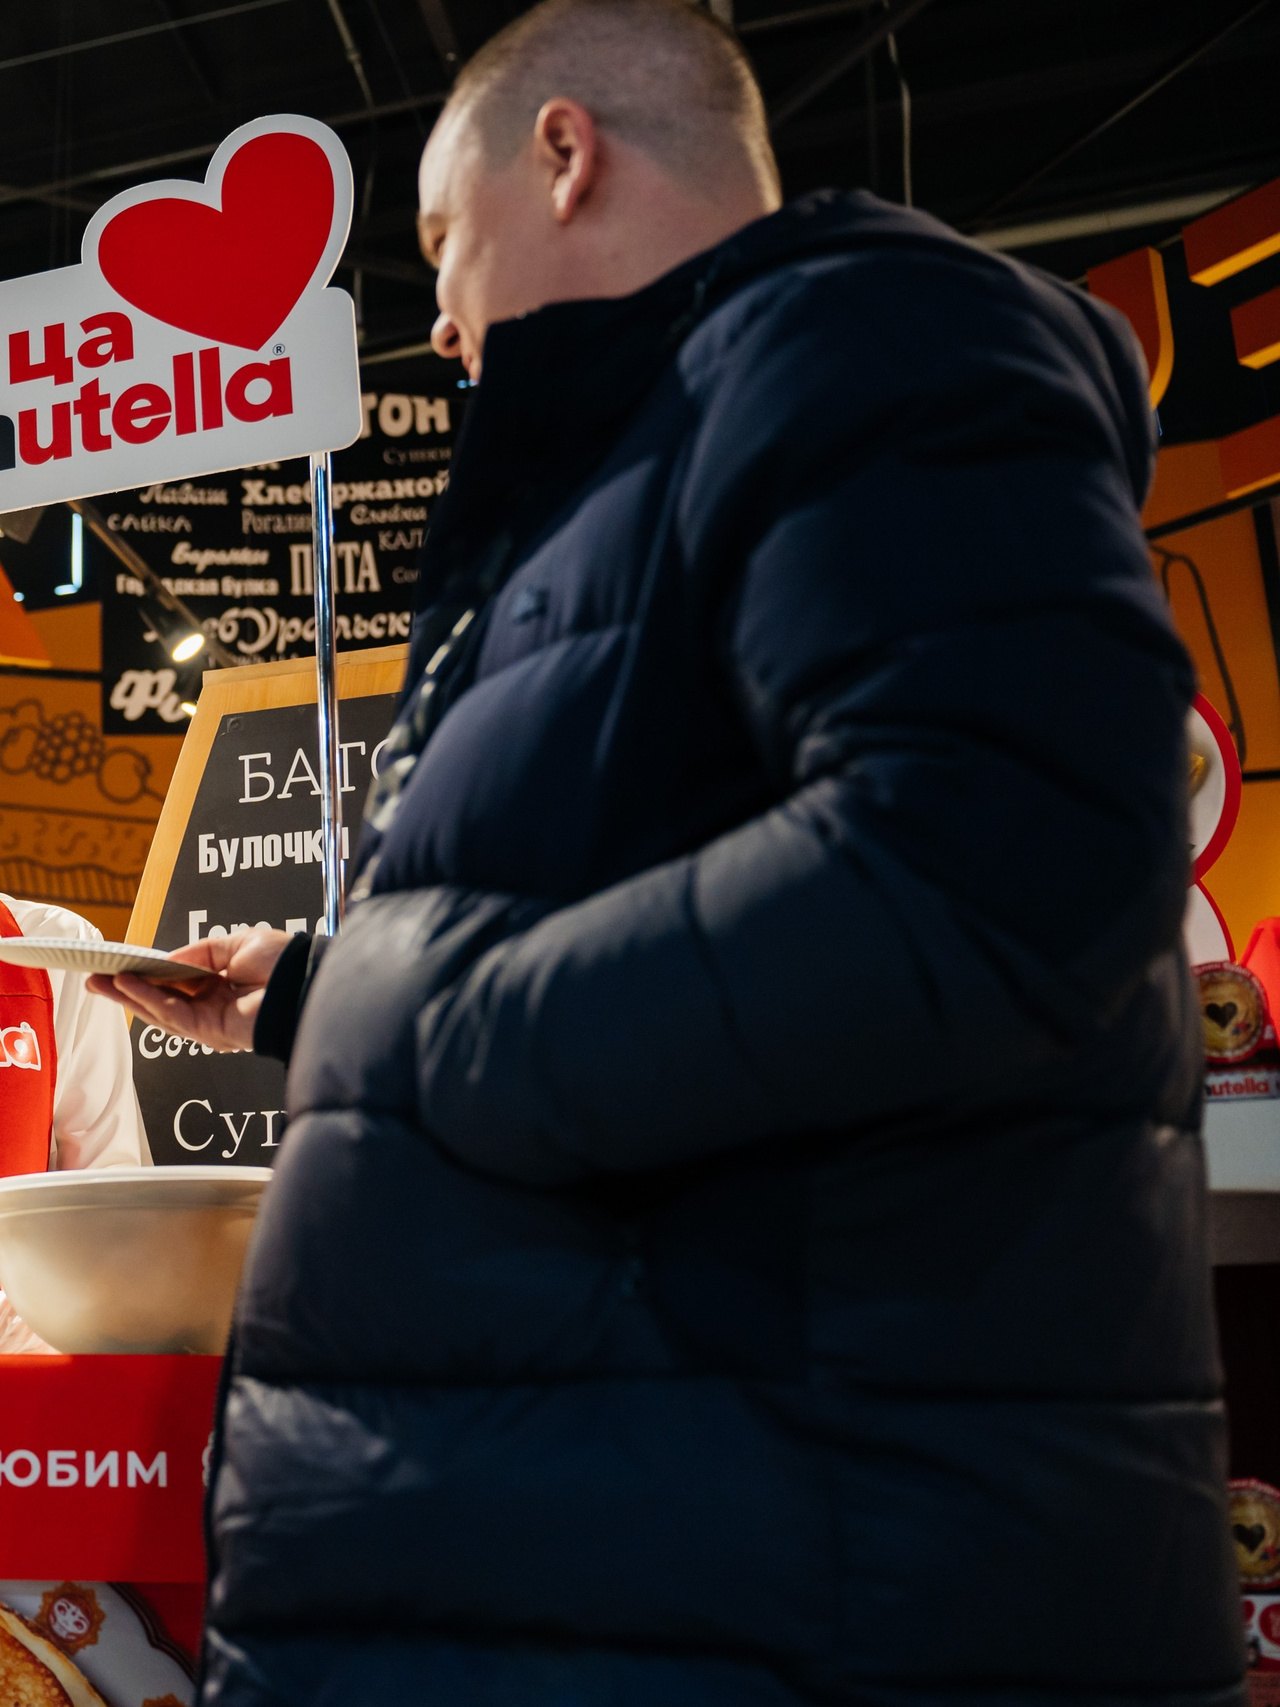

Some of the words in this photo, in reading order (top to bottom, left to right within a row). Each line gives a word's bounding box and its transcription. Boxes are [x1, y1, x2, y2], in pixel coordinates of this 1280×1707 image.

[241, 509, 312, 534] Рогали
[378, 528, 424, 551] КАЛ
[289, 541, 381, 596] ПТА
